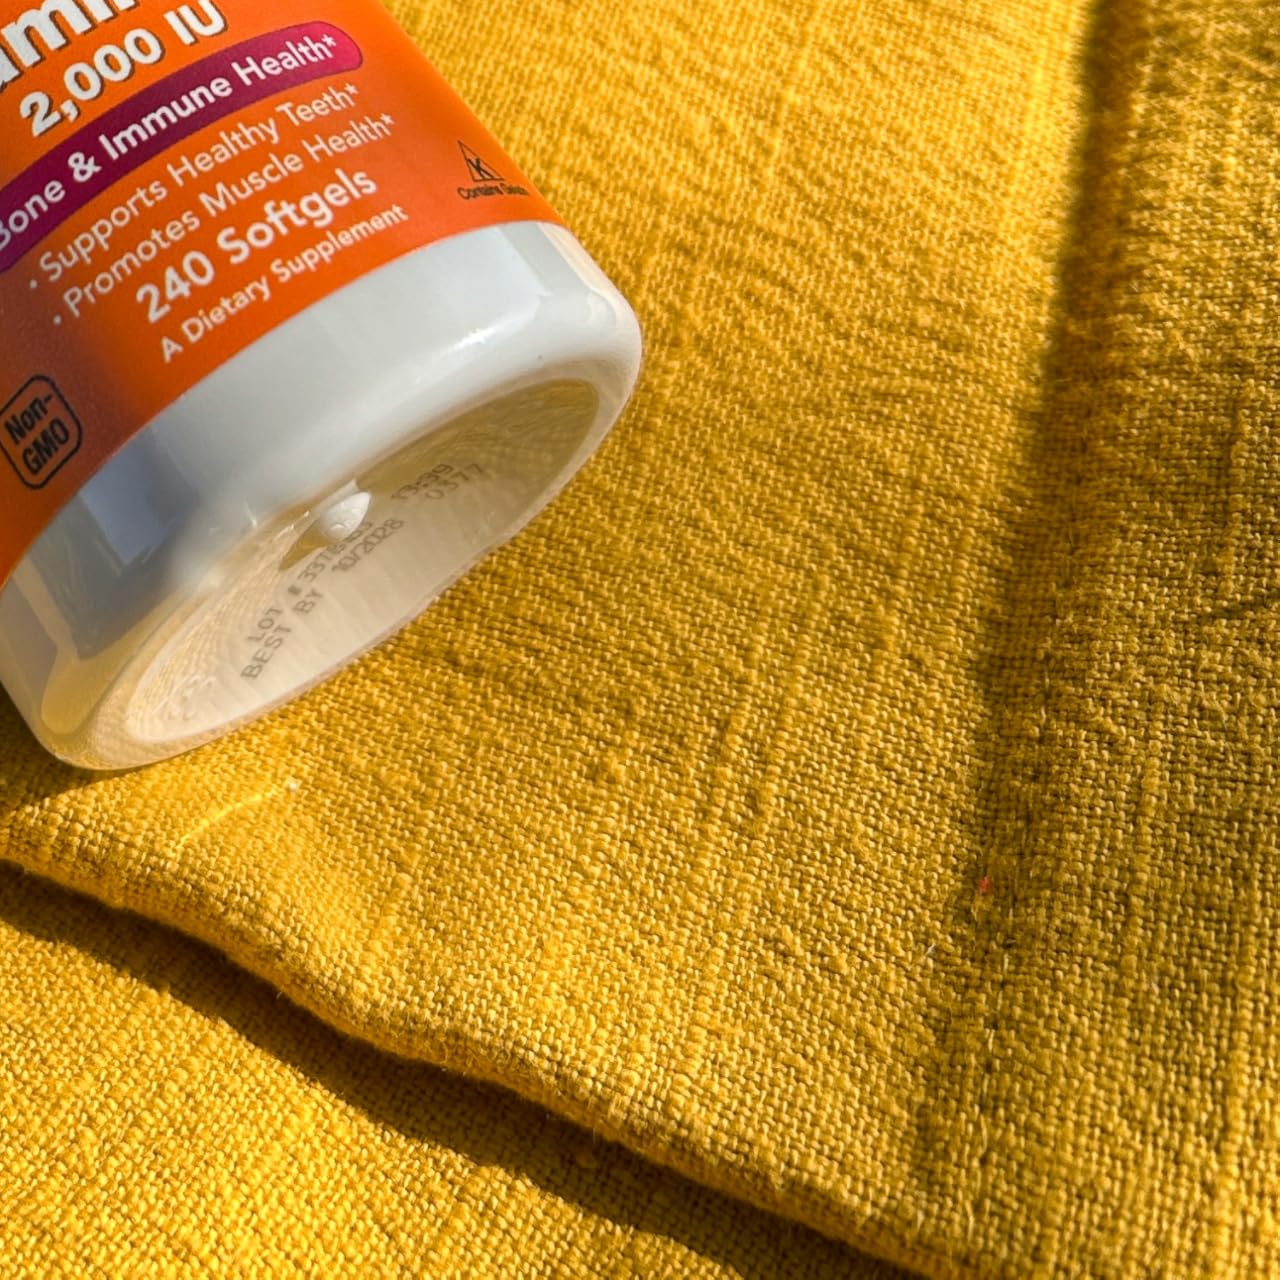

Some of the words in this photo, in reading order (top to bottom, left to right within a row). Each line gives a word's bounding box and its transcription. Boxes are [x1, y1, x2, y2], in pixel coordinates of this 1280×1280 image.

[20, 27, 164, 138] 2,000
[67, 151, 102, 183] &
[98, 76, 233, 160] Immune
[39, 179, 168, 282] Supports
[166, 117, 280, 187] Healthy
[62, 208, 201, 317] Promotes
[198, 151, 304, 218] Muscle
[136, 251, 216, 324] 240
[217, 167, 378, 265] Softgels
[159, 337, 183, 364] A
[181, 274, 272, 344] Dietary
[270, 203, 409, 284] Supplement
[4, 393, 53, 446] Non-
[22, 417, 70, 475] GMO
[240, 624, 293, 681] BEST
[293, 589, 324, 615] BY
[247, 606, 284, 644] LOT
